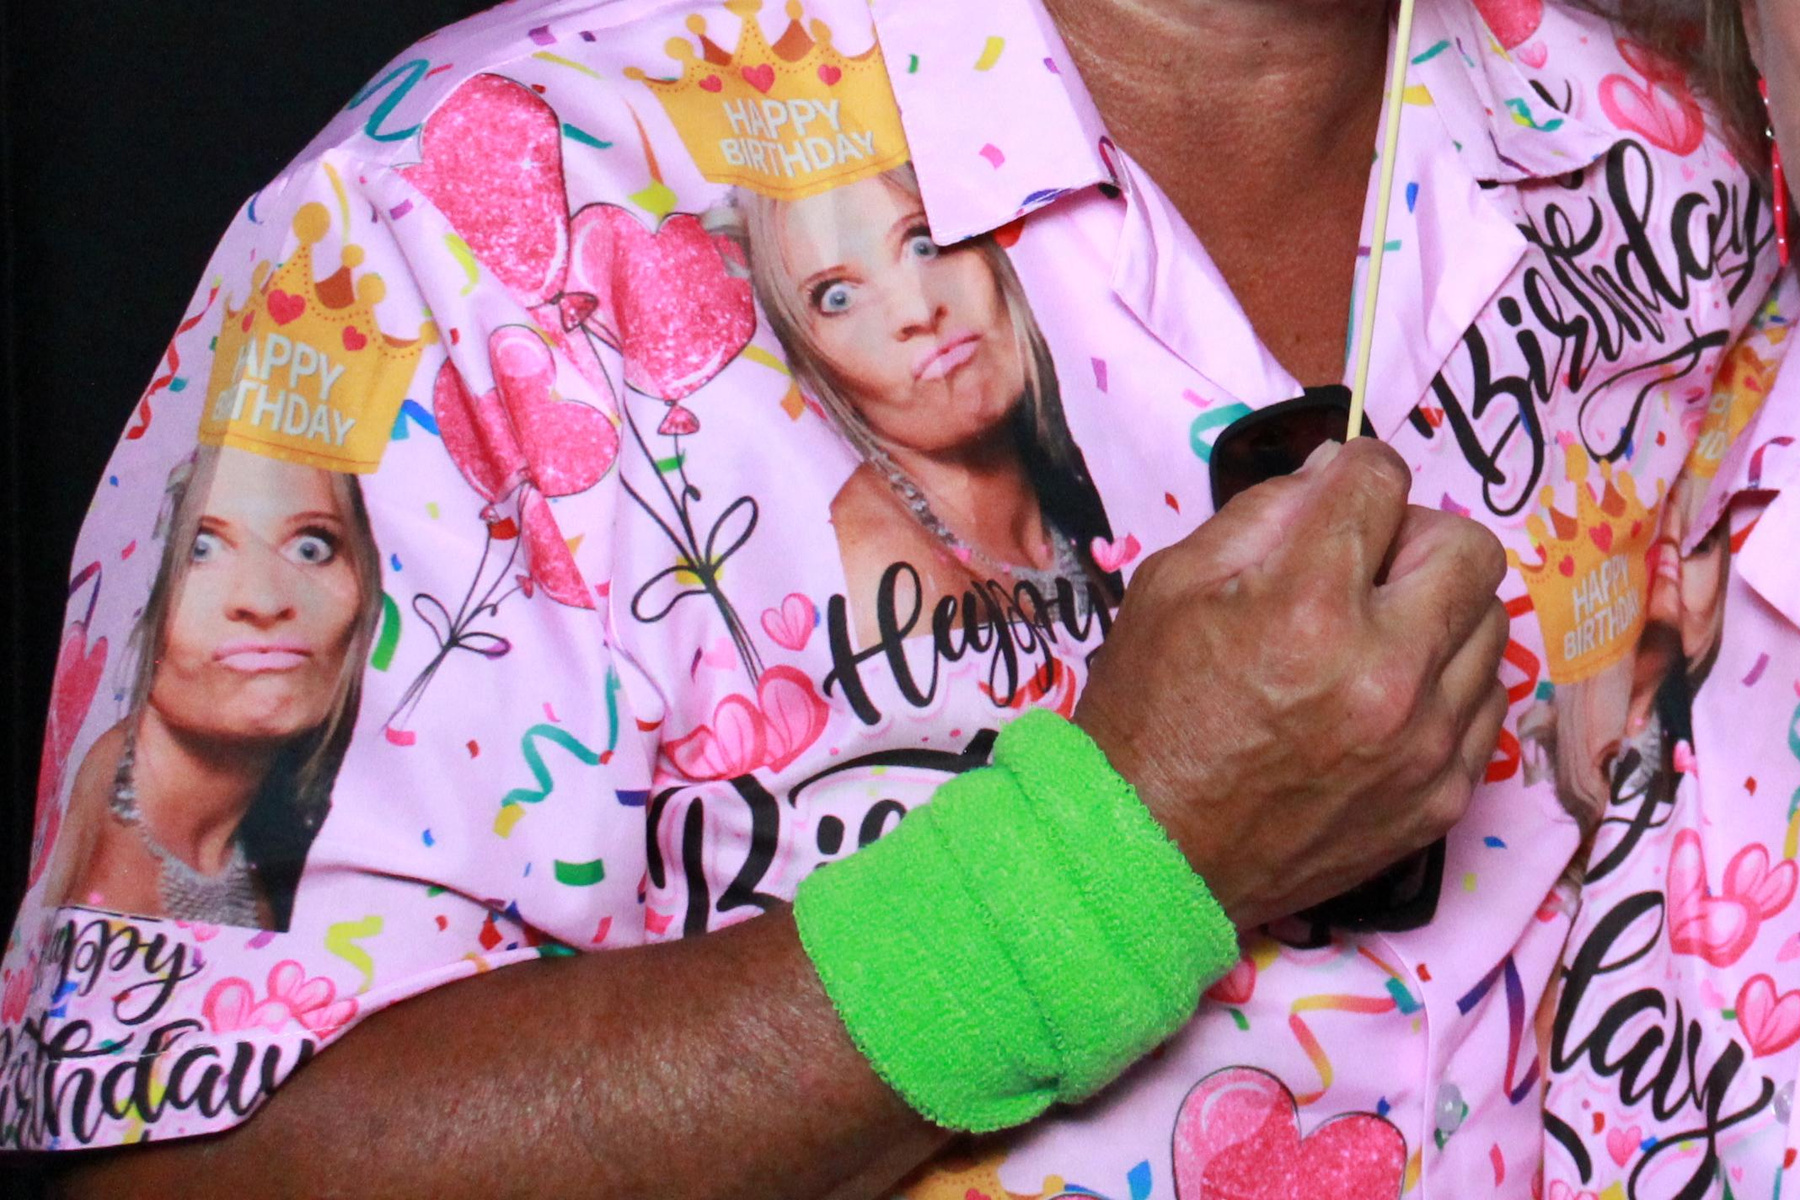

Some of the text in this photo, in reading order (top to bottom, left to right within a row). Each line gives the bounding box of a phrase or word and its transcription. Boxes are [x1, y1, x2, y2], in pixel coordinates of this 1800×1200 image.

[723, 97, 841, 140] HAPPY
[719, 130, 876, 178] BIRTHDAY
[231, 330, 346, 401] APPY
